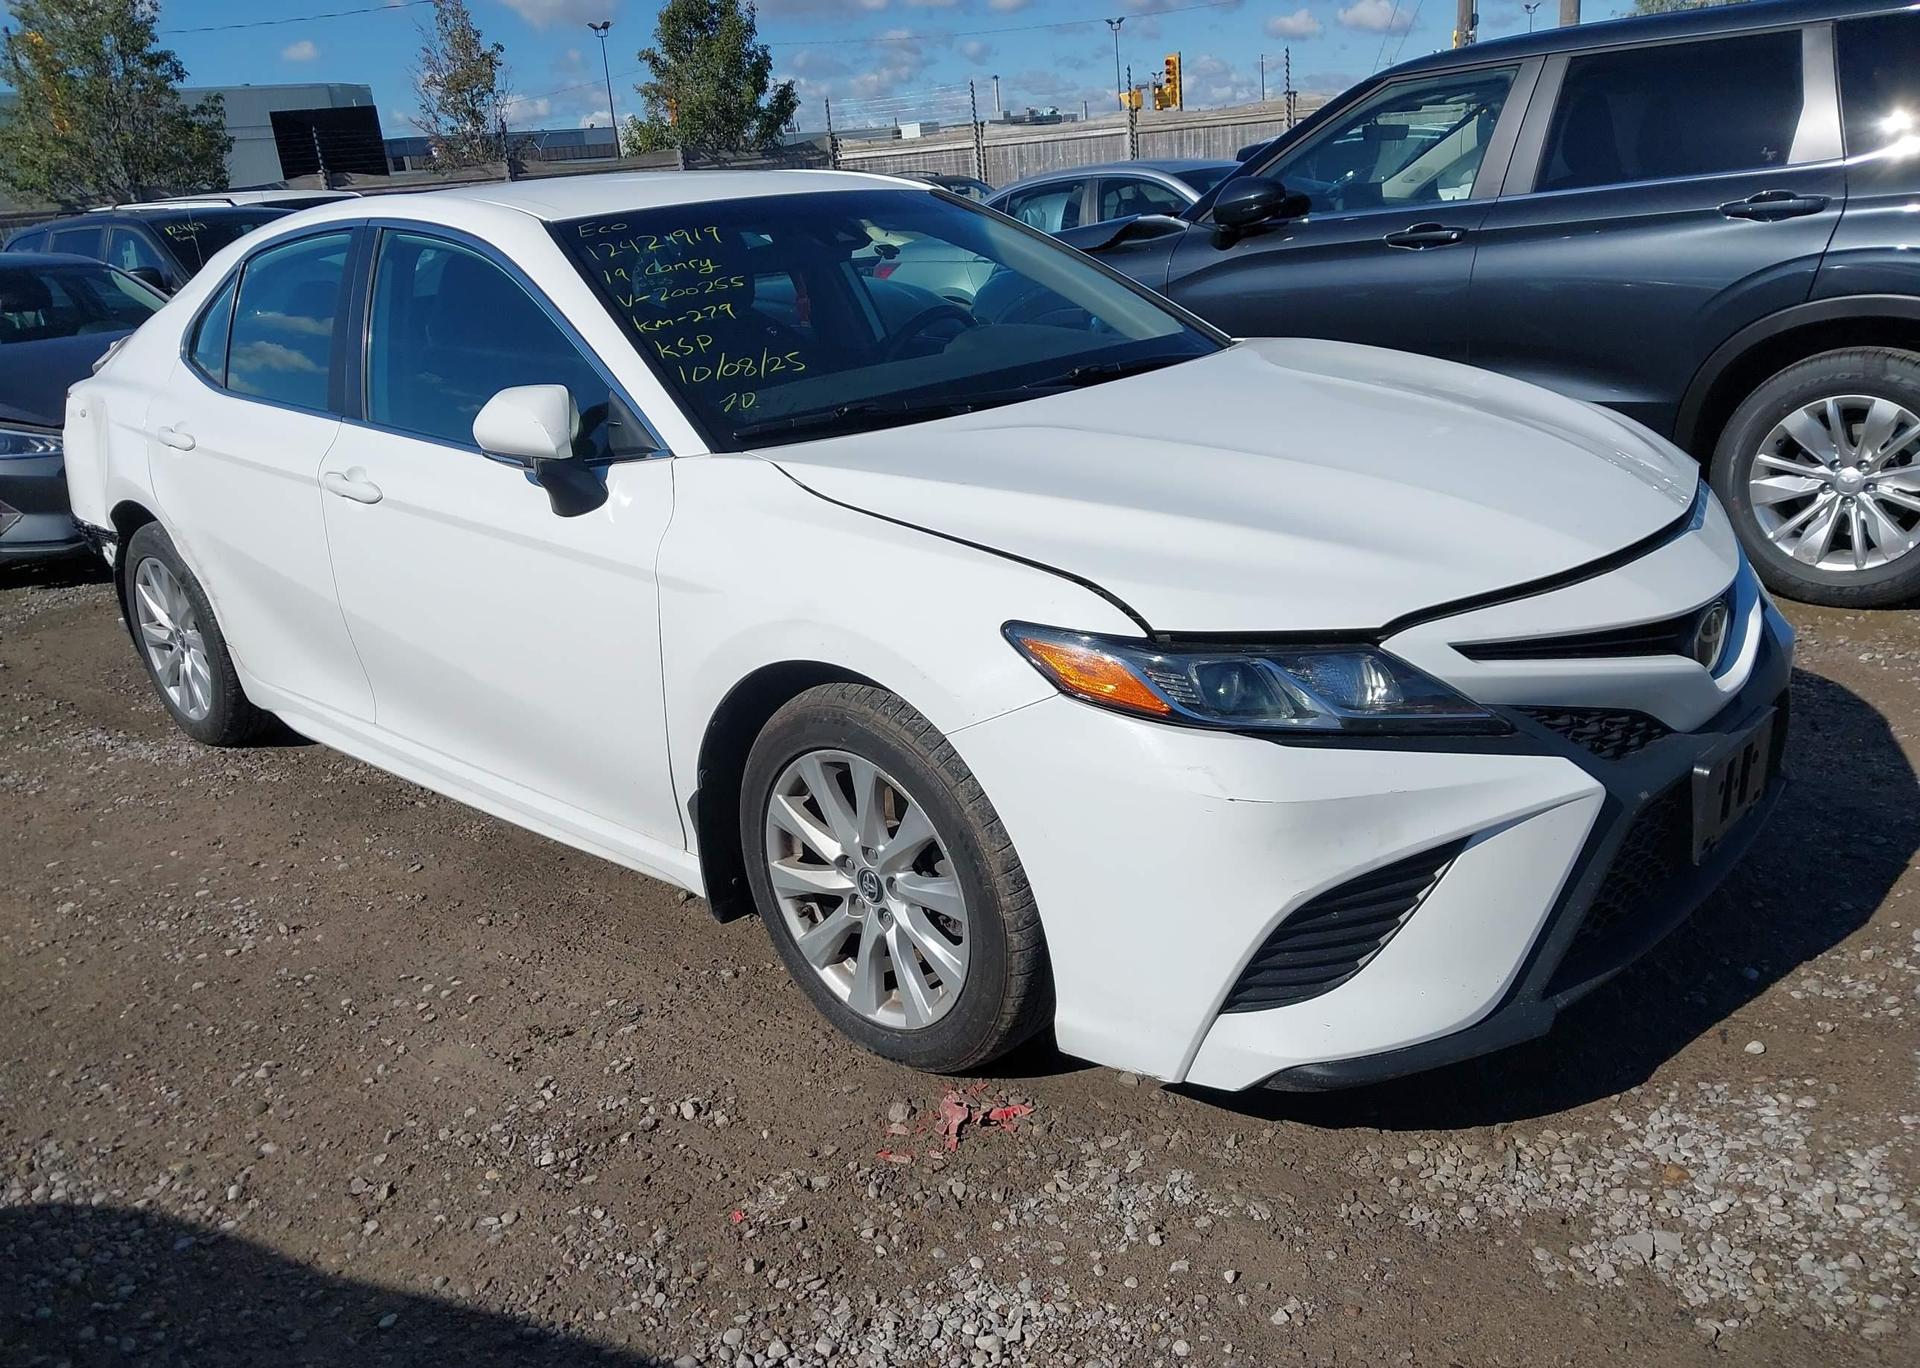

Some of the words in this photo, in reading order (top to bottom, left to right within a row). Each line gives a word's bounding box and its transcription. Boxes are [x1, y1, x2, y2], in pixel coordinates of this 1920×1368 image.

[578, 222, 628, 239] Eco
[603, 268, 631, 284] 19
[679, 347, 806, 384] 10/08/25
